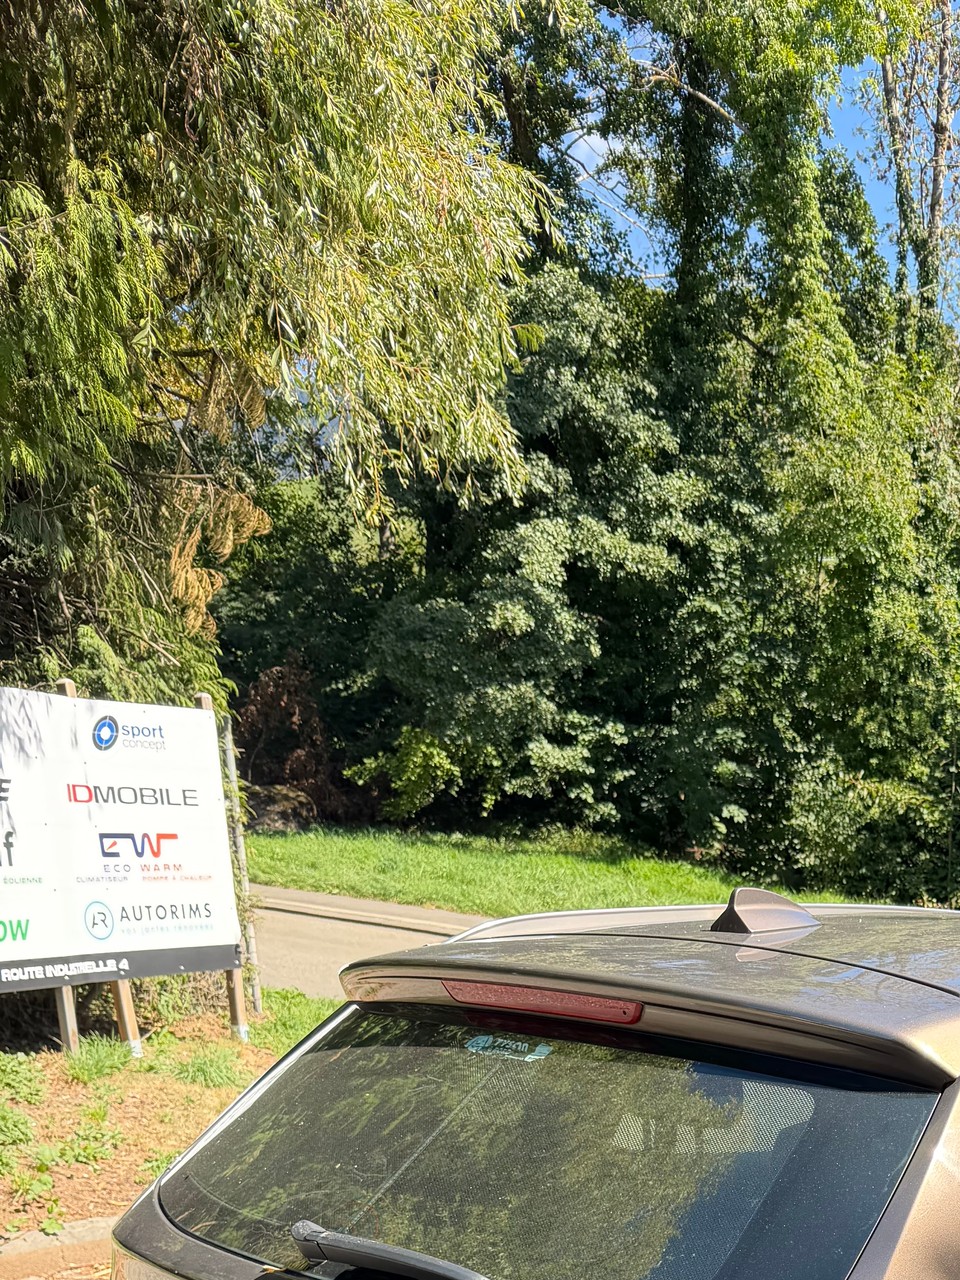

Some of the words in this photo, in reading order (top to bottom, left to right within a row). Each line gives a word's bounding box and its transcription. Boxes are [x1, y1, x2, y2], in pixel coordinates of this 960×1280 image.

[121, 725, 165, 739] sport
[122, 739, 166, 752] concept
[66, 783, 199, 807] IDMOBILE
[103, 864, 131, 873] ECO
[140, 863, 183, 872] WARM
[120, 903, 212, 922] AUTORIMS
[1, 966, 45, 982] ROUTE
[118, 958, 130, 970] 4
